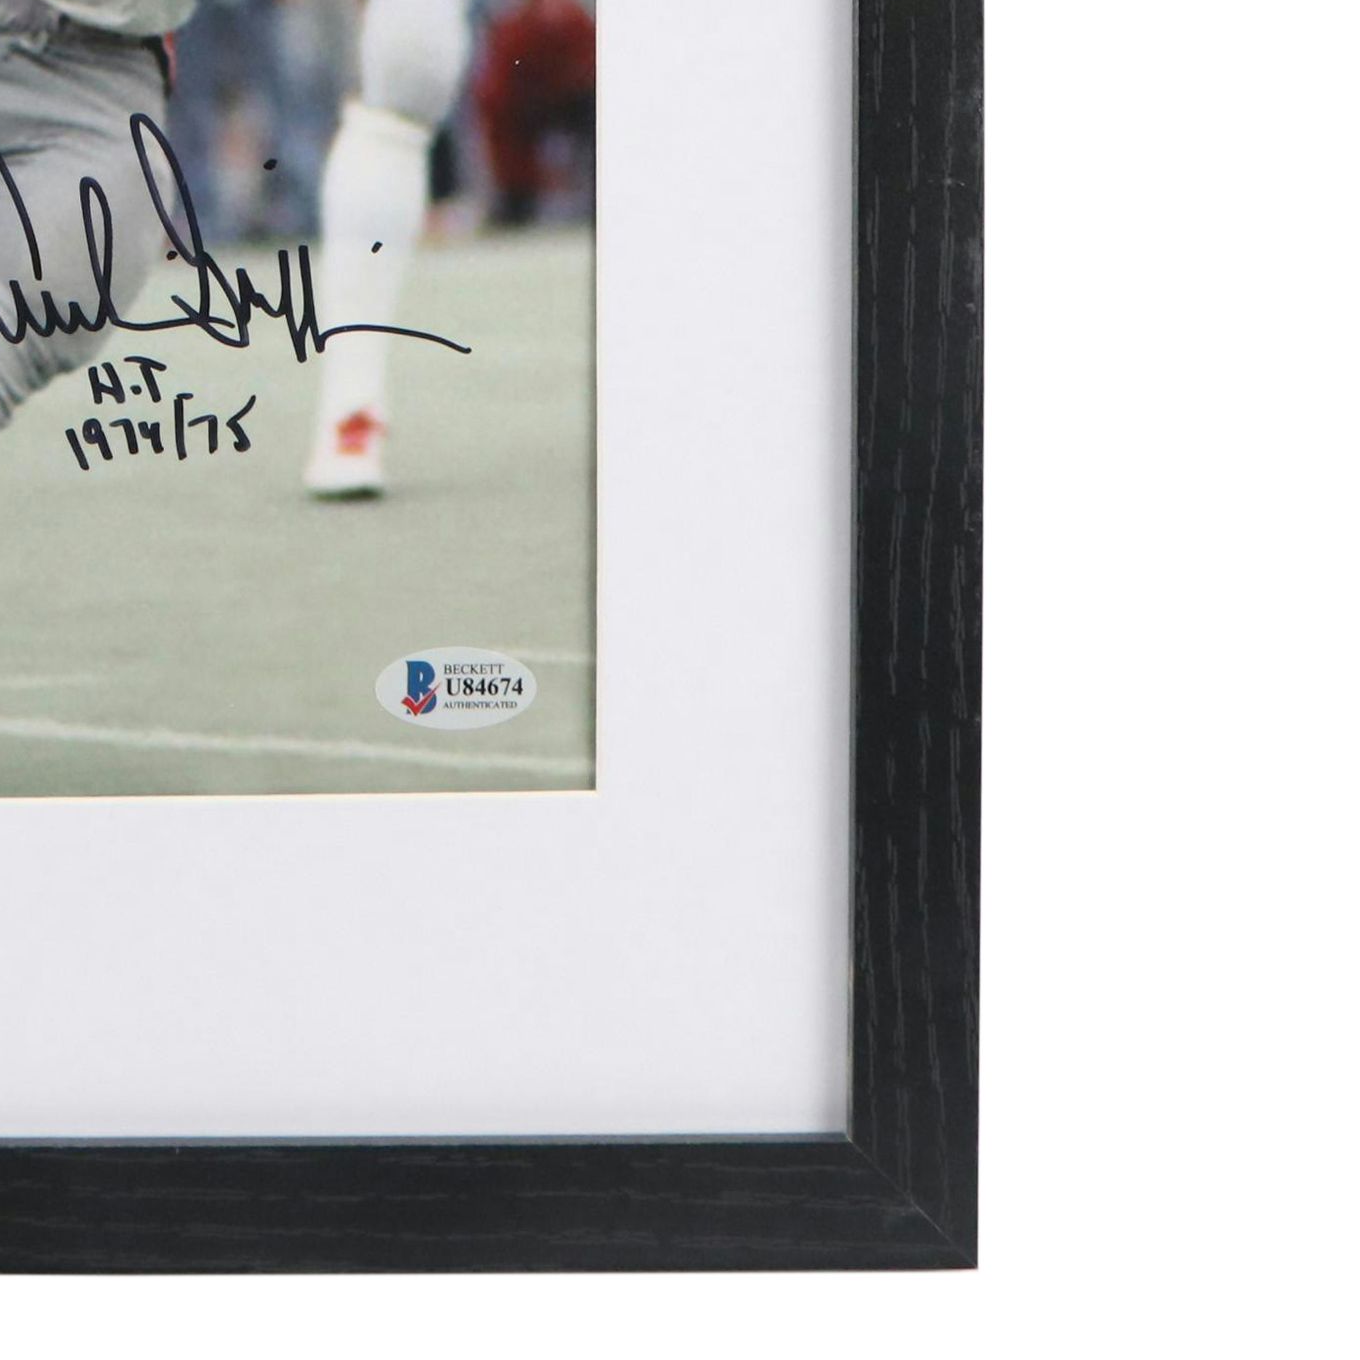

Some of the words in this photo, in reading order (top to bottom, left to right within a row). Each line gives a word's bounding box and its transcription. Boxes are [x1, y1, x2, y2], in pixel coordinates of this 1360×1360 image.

[65, 392, 256, 470] 1974/75
[443, 663, 505, 675] BECKETT
[445, 677, 524, 696] U84674
[442, 700, 518, 710] AUTHENTICATED
